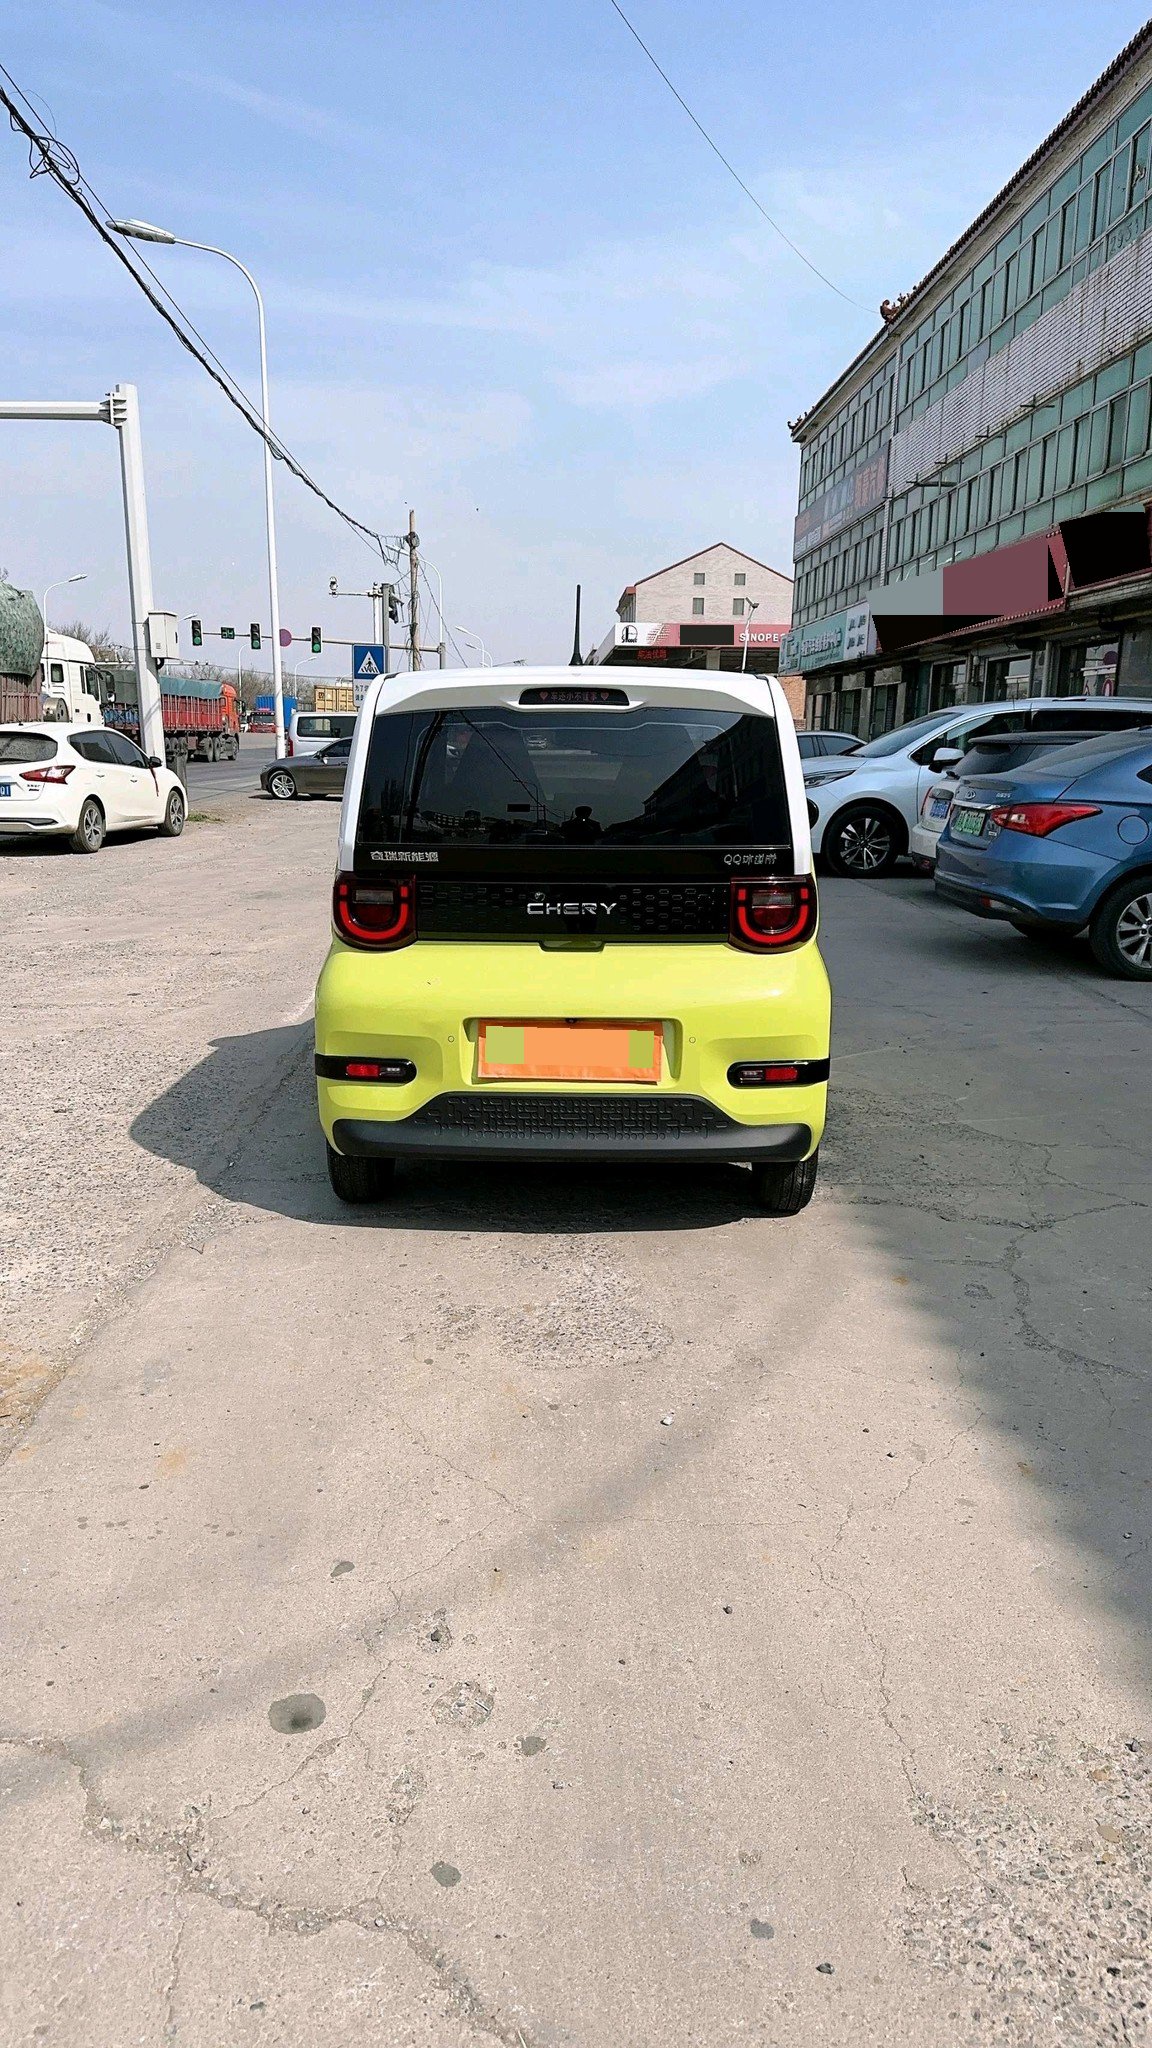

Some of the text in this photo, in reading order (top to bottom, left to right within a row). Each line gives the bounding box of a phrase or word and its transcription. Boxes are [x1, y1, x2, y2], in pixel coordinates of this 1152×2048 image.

[739, 633, 785, 642] SINOPE
[370, 850, 439, 862] 奇瑞新能源
[527, 902, 617, 915] CHERY
